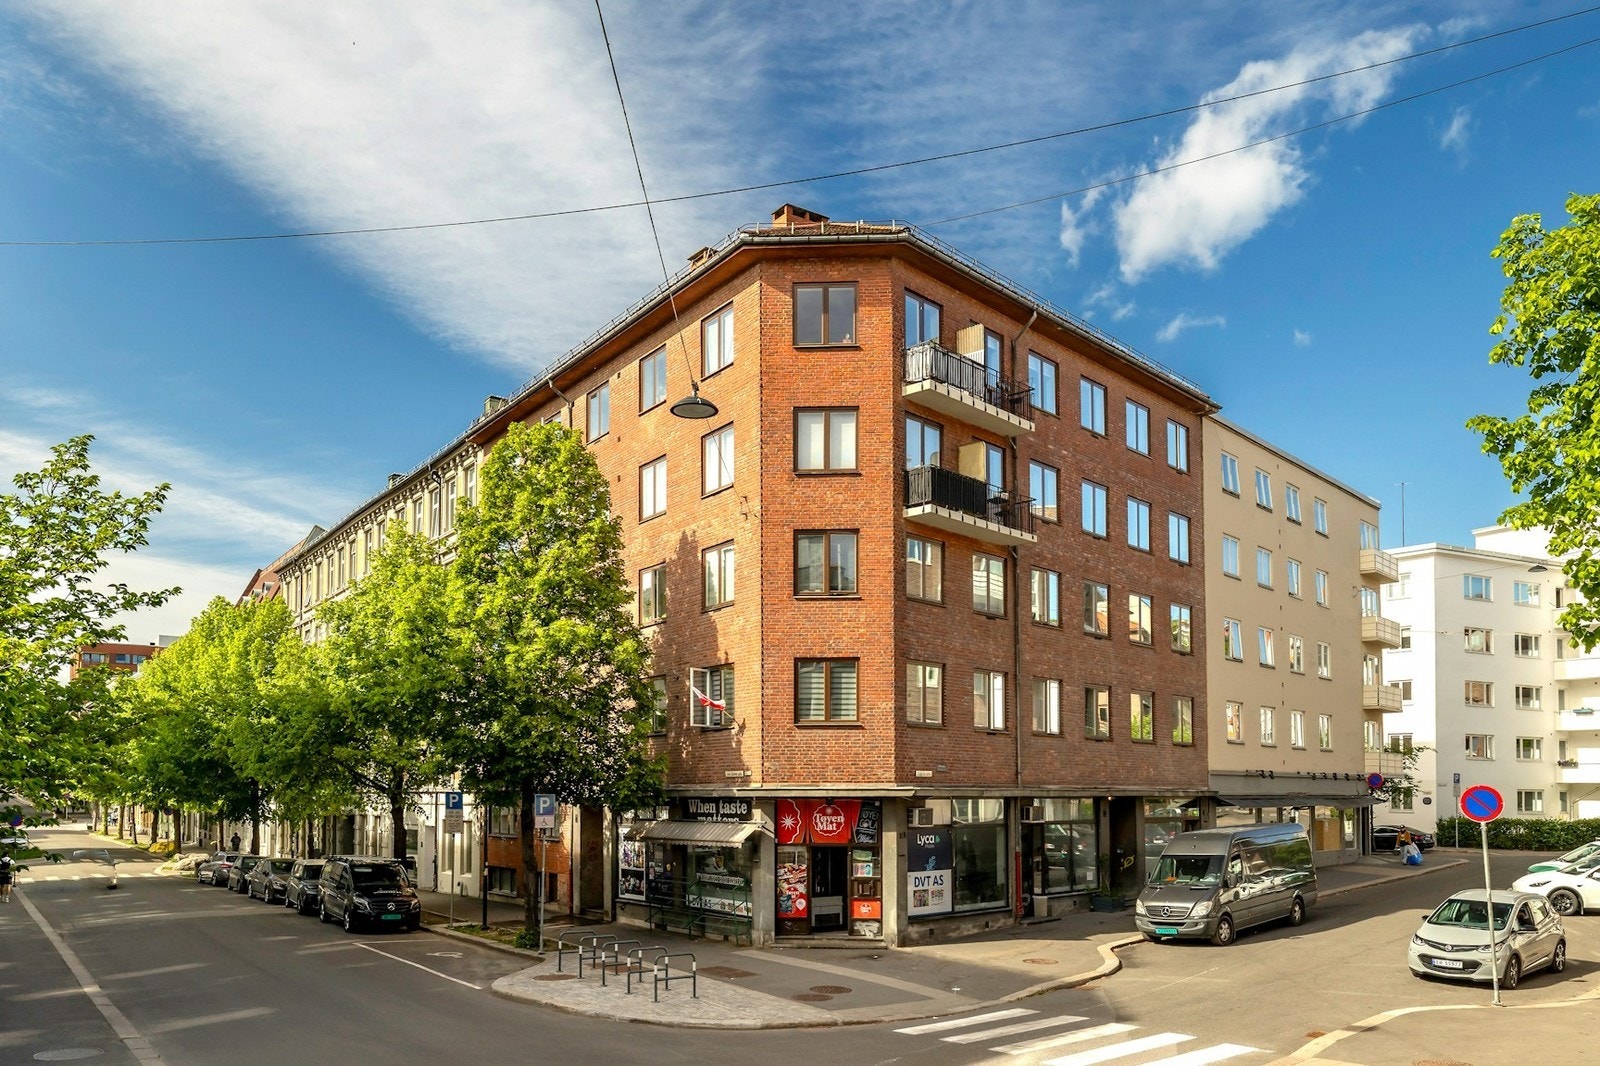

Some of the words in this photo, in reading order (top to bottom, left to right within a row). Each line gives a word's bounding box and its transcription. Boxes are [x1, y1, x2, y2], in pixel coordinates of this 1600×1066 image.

[449, 793, 459, 808] P
[539, 797, 550, 814] P
[688, 799, 716, 814] When
[719, 799, 747, 814] taste
[816, 822, 838, 831] Mat
[917, 833, 935, 846] Lyca
[914, 875, 931, 888] DVT
[933, 874, 944, 887] AS
